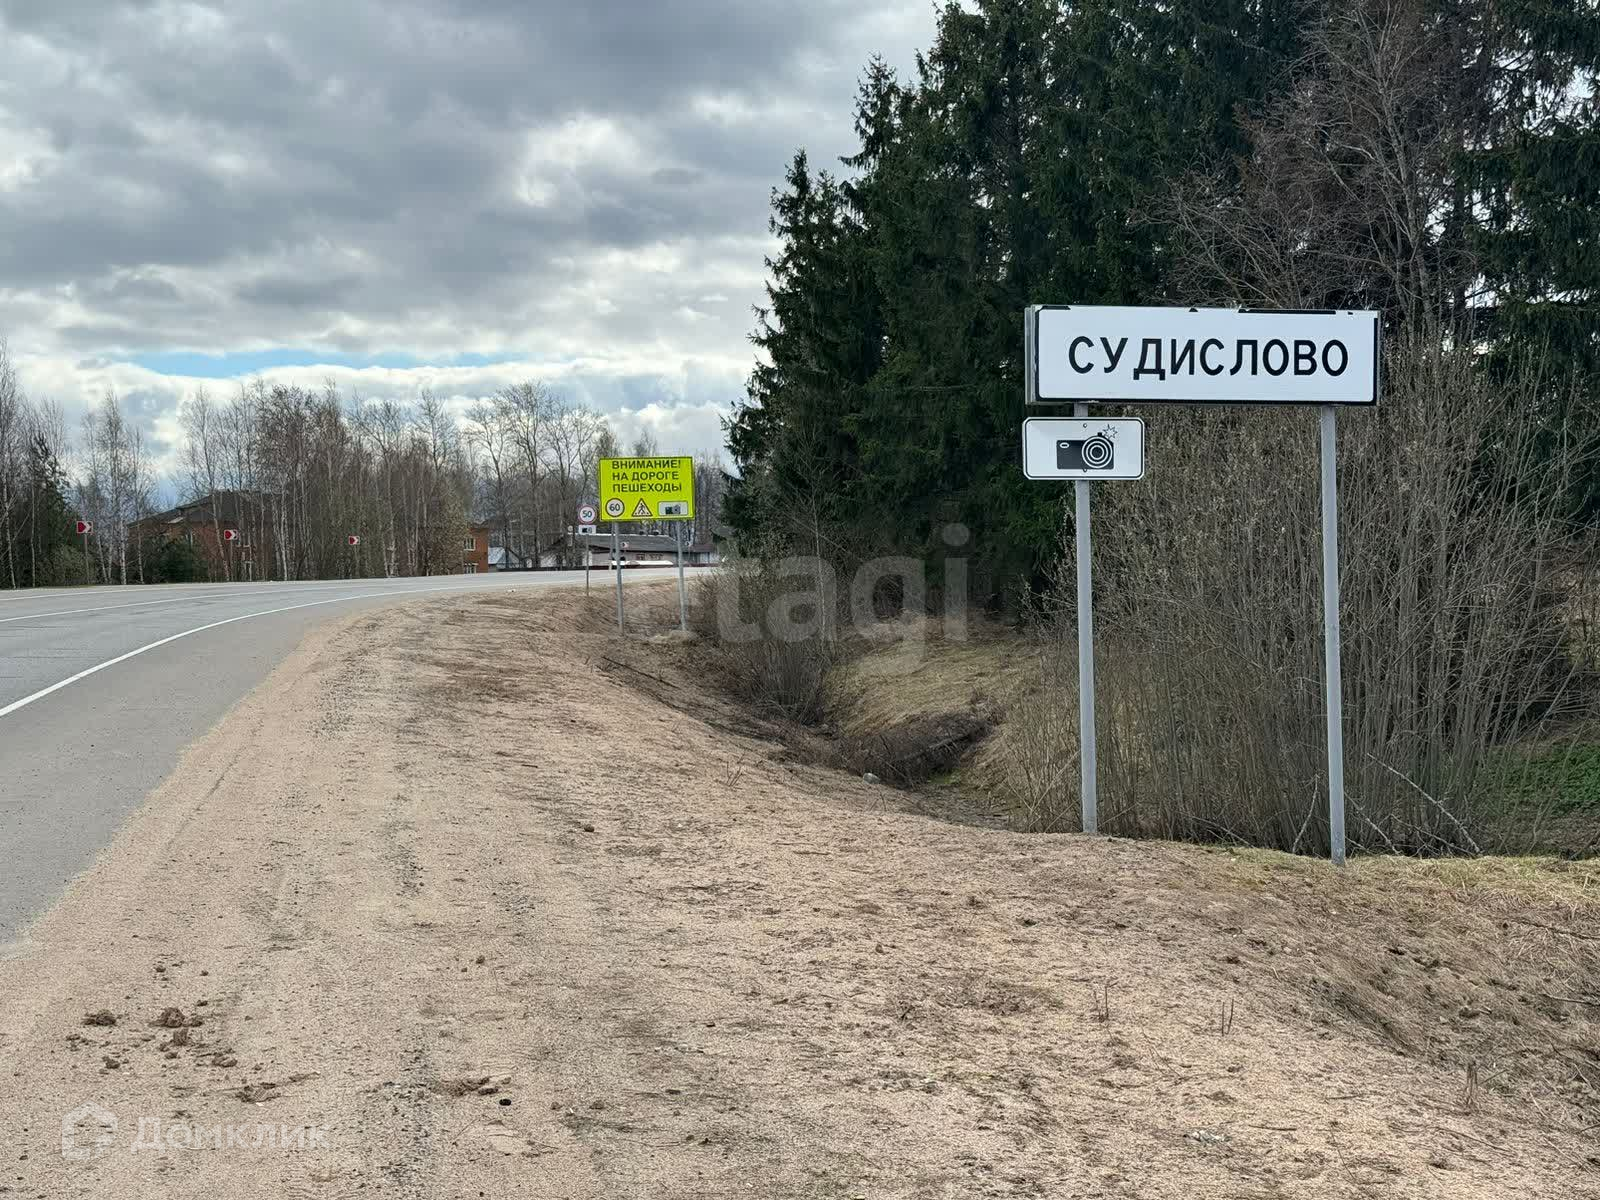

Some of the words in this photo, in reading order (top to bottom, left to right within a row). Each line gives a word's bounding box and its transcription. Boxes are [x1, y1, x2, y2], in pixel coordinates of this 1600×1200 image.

[1068, 336, 1349, 381] СУДИСЛОВО
[612, 459, 681, 470] ВНИМАНИЕ!
[612, 472, 628, 481] НА
[632, 471, 679, 482] ДОРОГЕ
[612, 483, 682, 493] ПЕШЕХОДЫ
[609, 503, 621, 512] 60
[582, 510, 592, 518] 50
